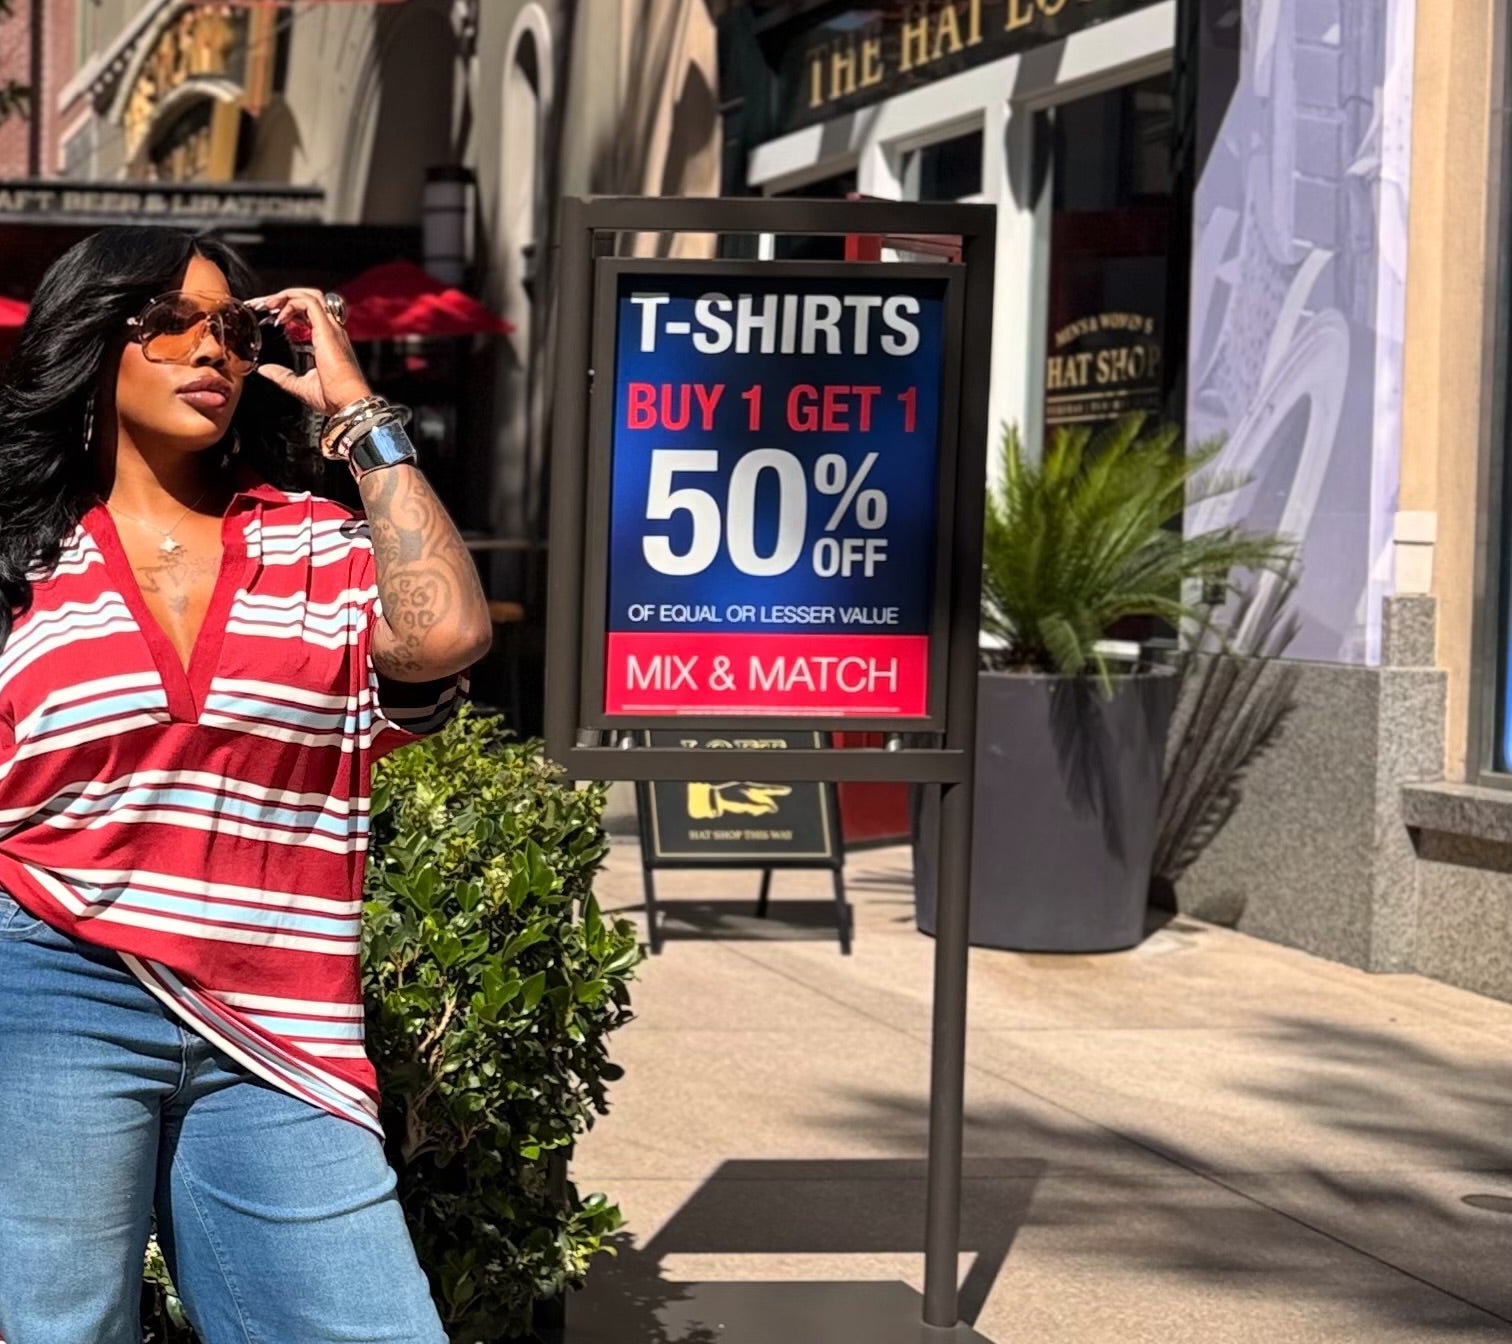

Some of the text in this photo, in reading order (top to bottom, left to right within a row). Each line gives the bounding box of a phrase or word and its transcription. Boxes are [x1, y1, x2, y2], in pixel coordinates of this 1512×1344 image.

[806, 35, 886, 108] THE
[61, 190, 141, 213] BEER
[629, 291, 921, 357] T-SHIRTS
[1047, 344, 1161, 390] HAT SHOP
[626, 382, 918, 433] BUY 1 GET 1
[641, 447, 889, 577] 50%
[811, 537, 889, 578] OFF
[627, 604, 900, 625] OF EQUAL OR LESSER VALUE
[625, 655, 898, 693] MIX & MATCH
